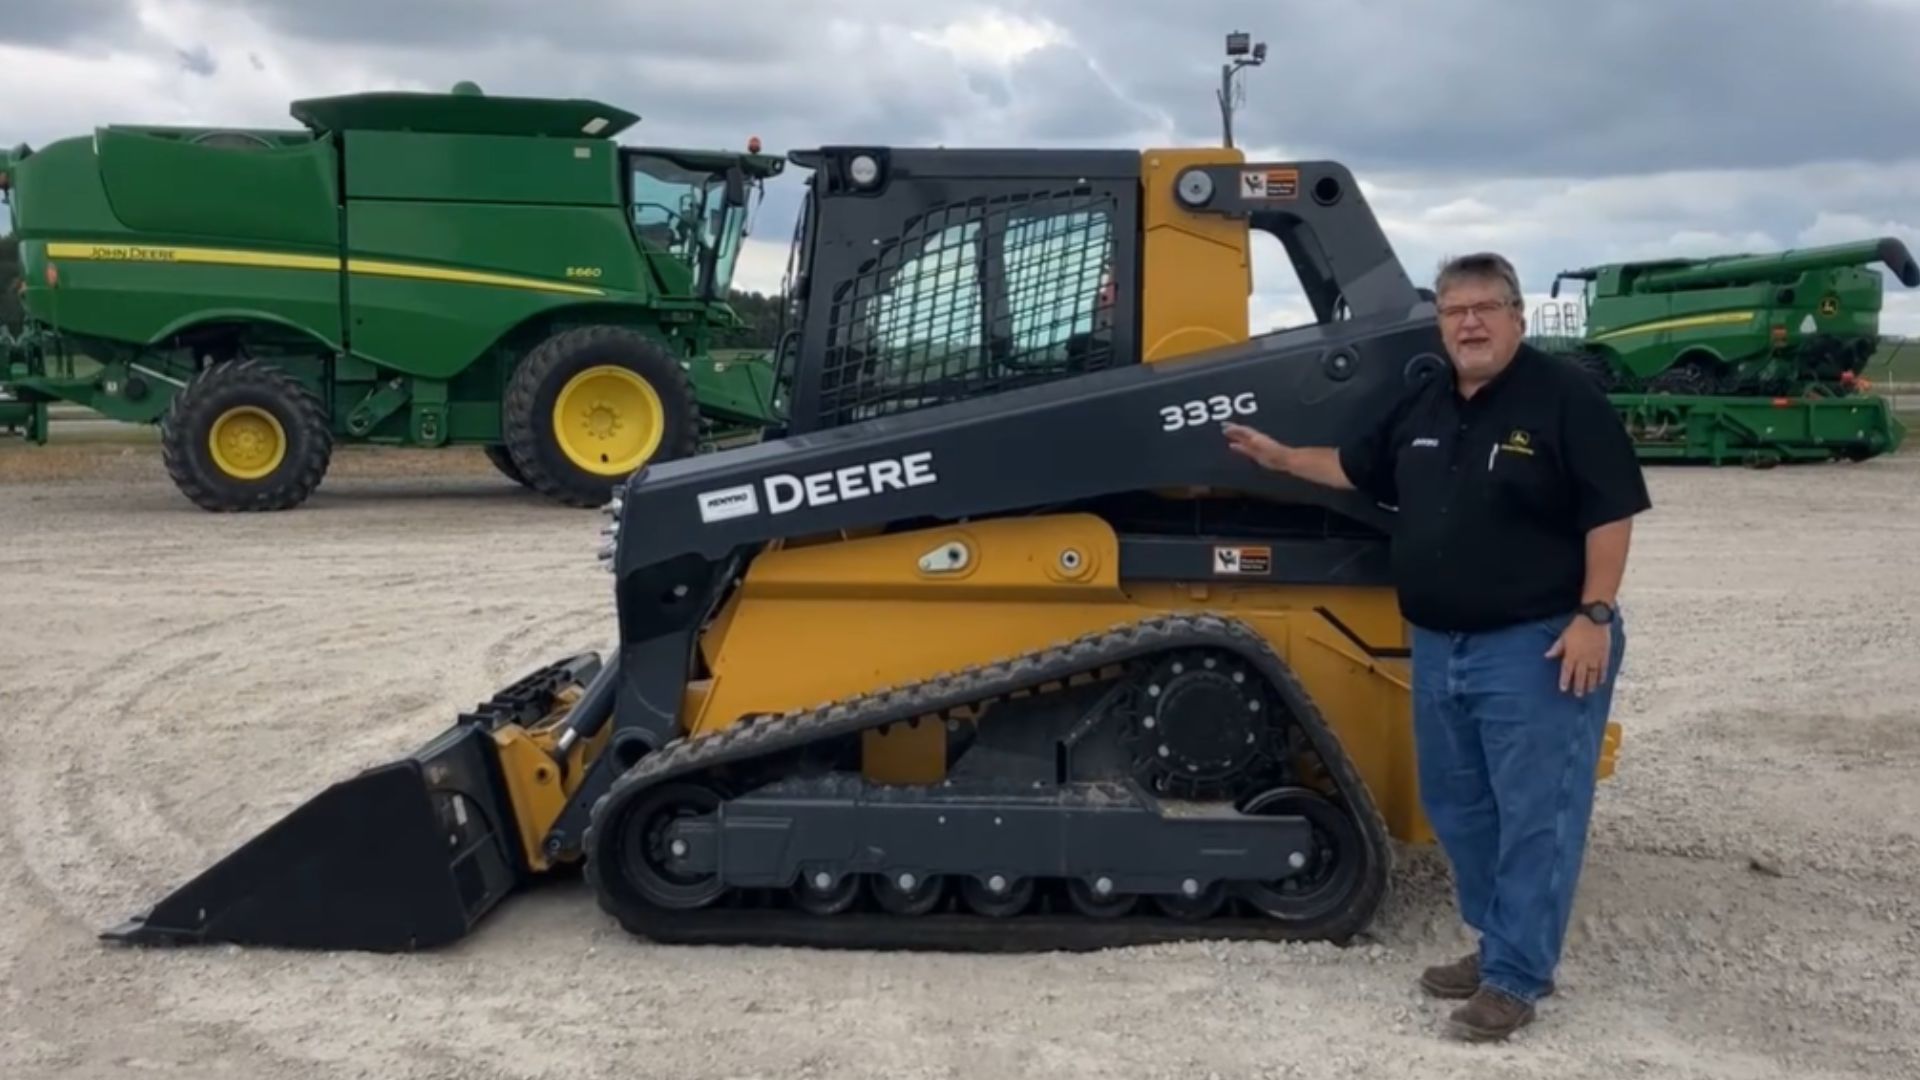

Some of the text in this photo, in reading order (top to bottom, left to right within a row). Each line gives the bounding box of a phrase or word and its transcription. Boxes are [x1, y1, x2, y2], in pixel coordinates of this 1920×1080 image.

[91, 246, 176, 260] JOHN DEERE
[1160, 392, 1258, 431] 333G
[764, 452, 937, 514] DEERE
